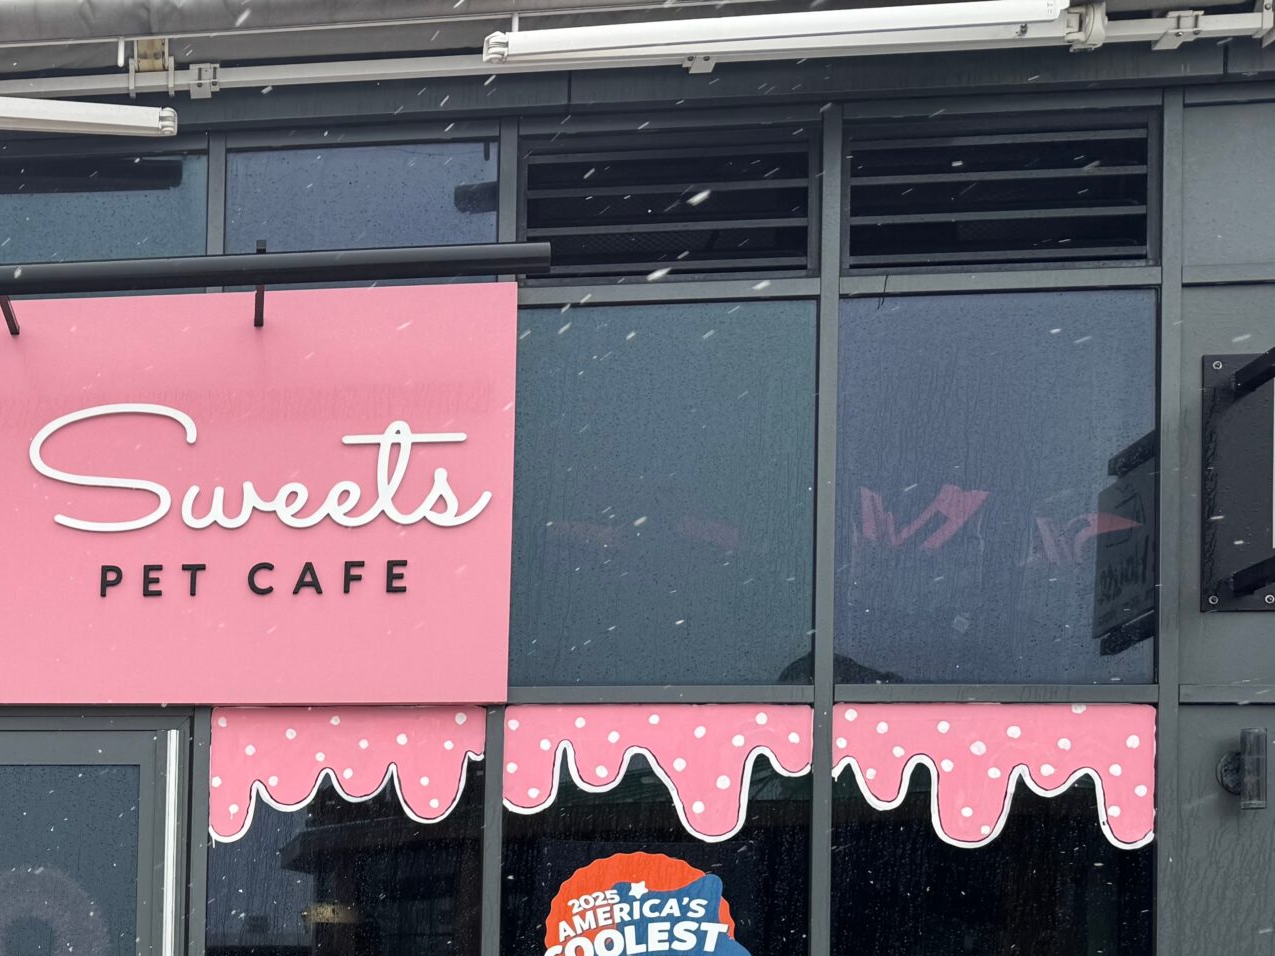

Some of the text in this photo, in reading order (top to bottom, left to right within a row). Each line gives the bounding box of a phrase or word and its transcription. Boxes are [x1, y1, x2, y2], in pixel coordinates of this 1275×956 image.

[29, 403, 493, 532] Sweets
[100, 559, 408, 598] PET CAFE
[557, 897, 708, 943] AMERICA'S
[567, 889, 621, 914] 2025
